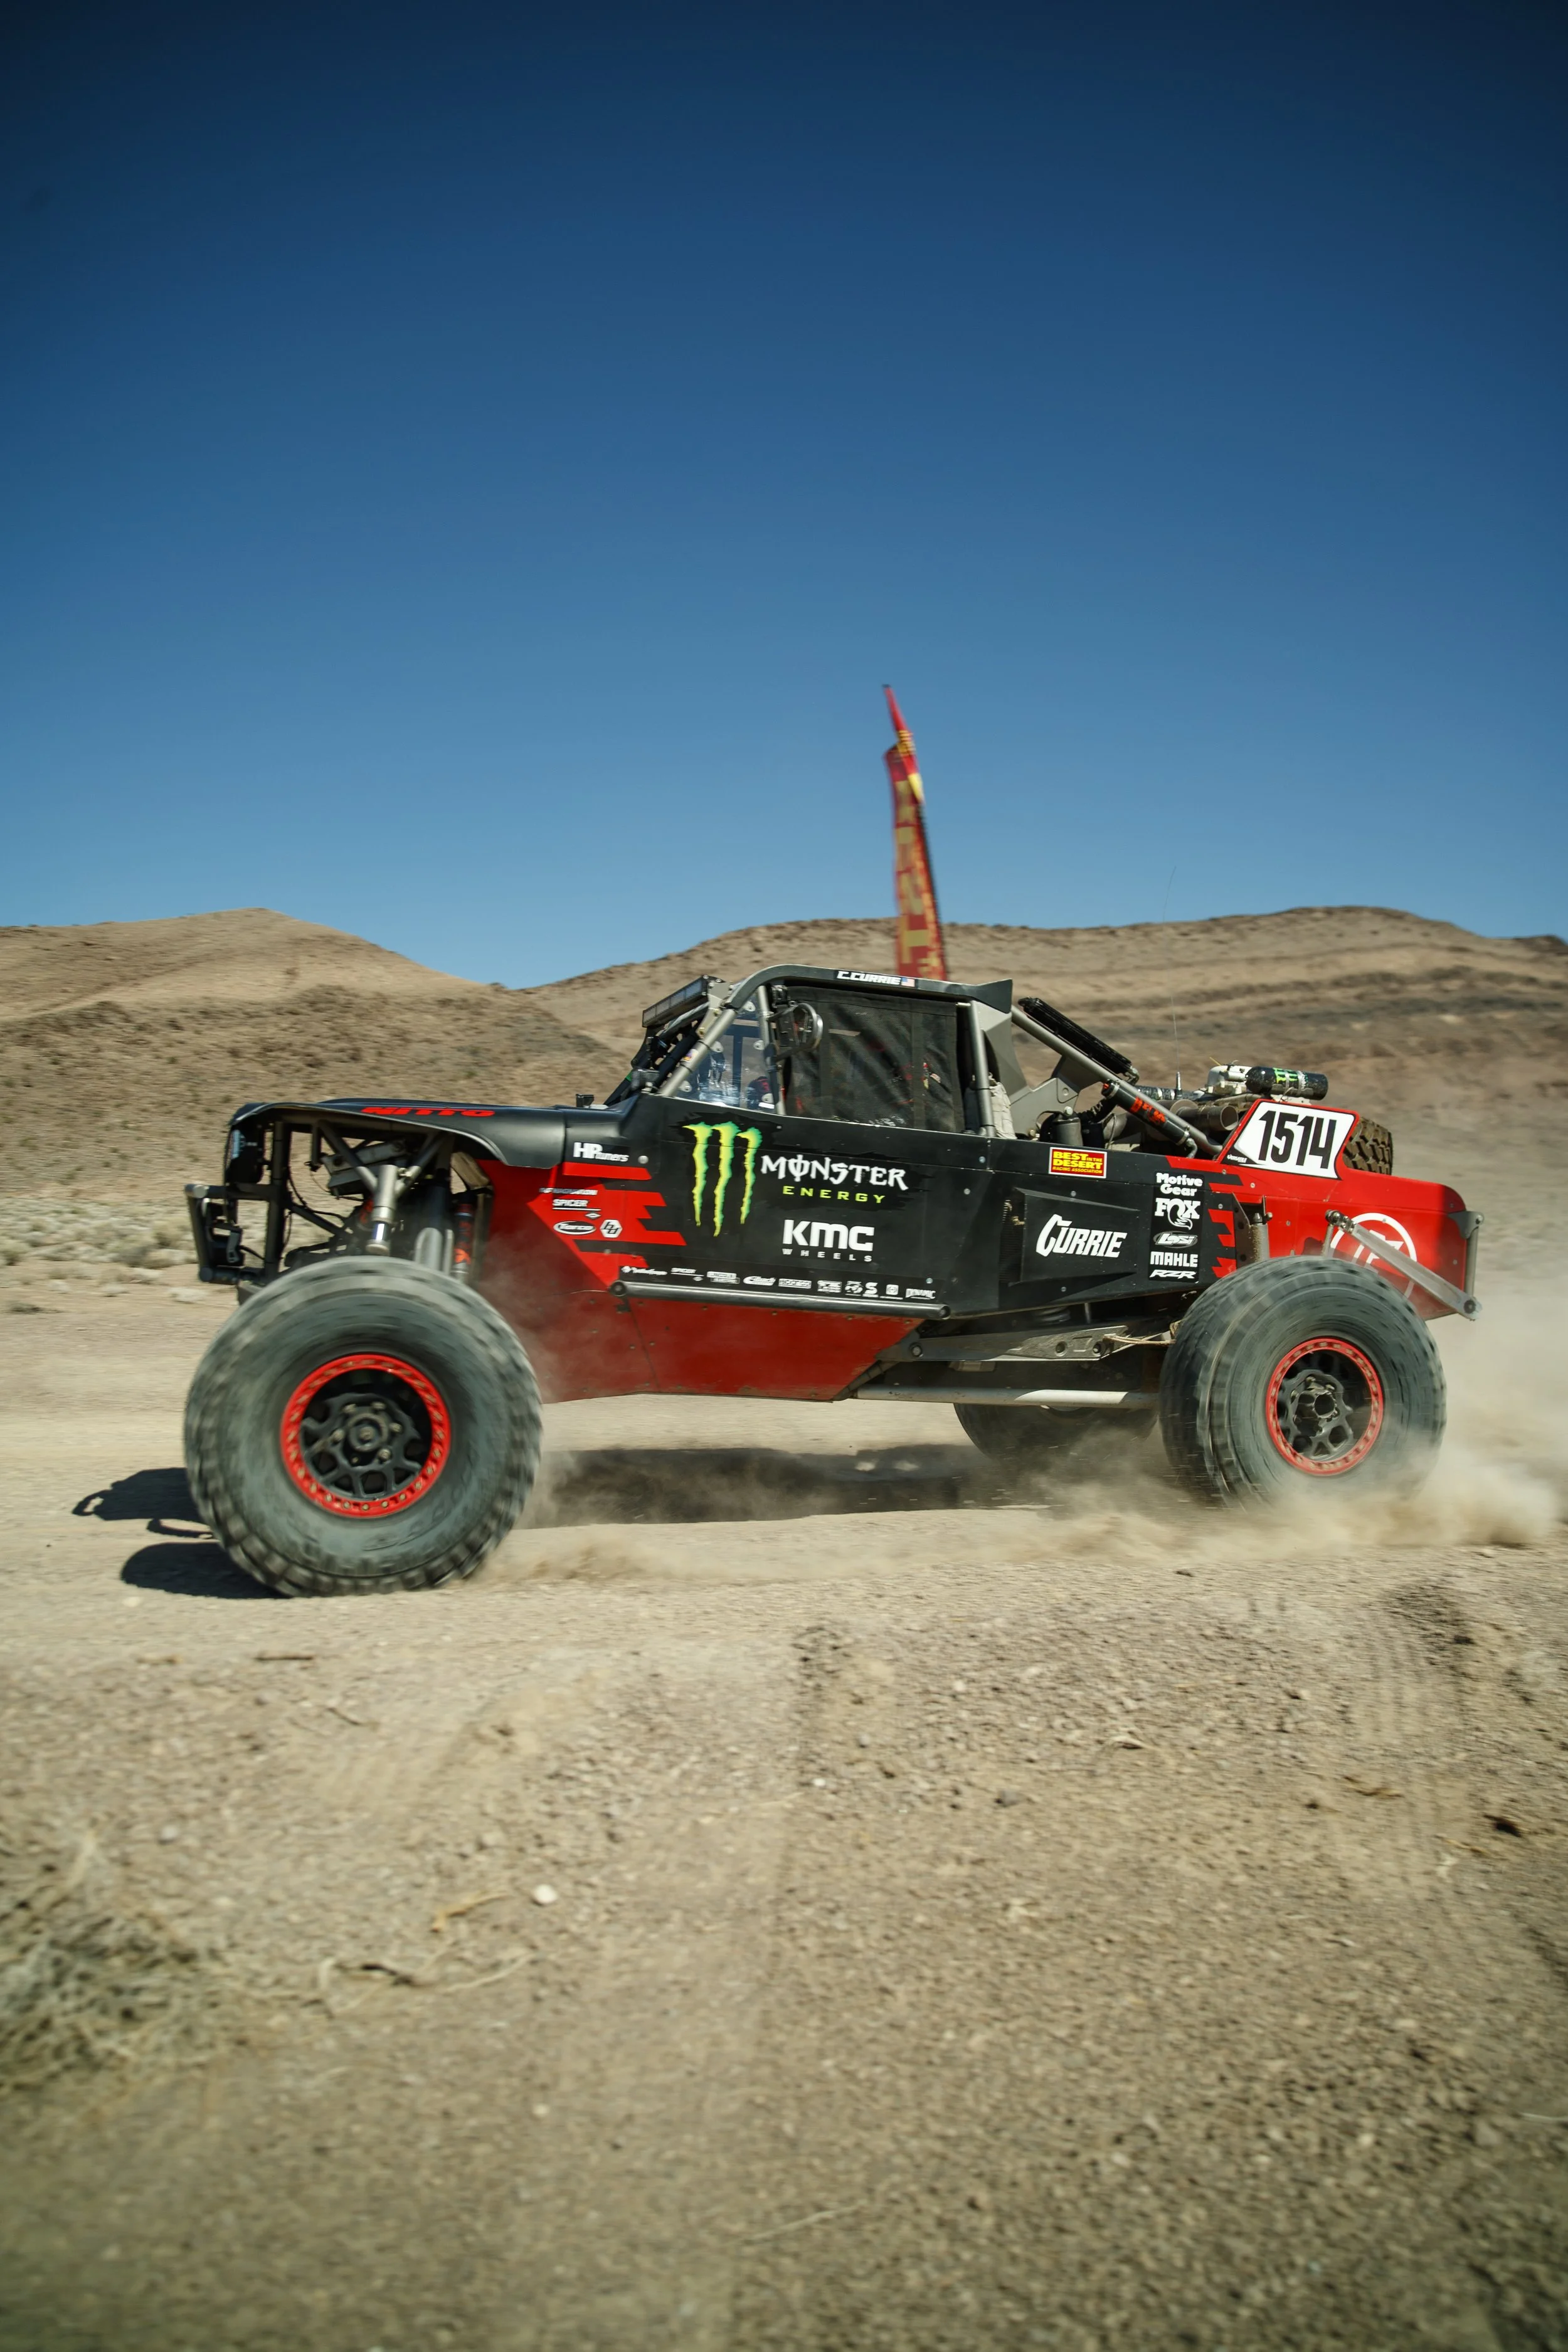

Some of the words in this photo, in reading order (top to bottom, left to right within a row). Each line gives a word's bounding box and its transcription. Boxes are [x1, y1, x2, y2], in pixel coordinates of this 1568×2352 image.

[361, 1107, 495, 1117] NITTO
[1259, 1110, 1337, 1169] 1514
[1052, 1158, 1103, 1169] DESERT
[1053, 1151, 1089, 1161] BEST
[761, 1154, 909, 1190] MONSTER
[1156, 1172, 1203, 1187] Motive
[783, 1185, 886, 1203] ENERGY
[1160, 1184, 1197, 1196] Gear
[1155, 1197, 1201, 1230] FOX
[1036, 1214, 1128, 1258] CURRIE
[782, 1248, 872, 1262] WHEELS
[1150, 1251, 1199, 1268] MAHLE
[1149, 1269, 1197, 1279] RZR
